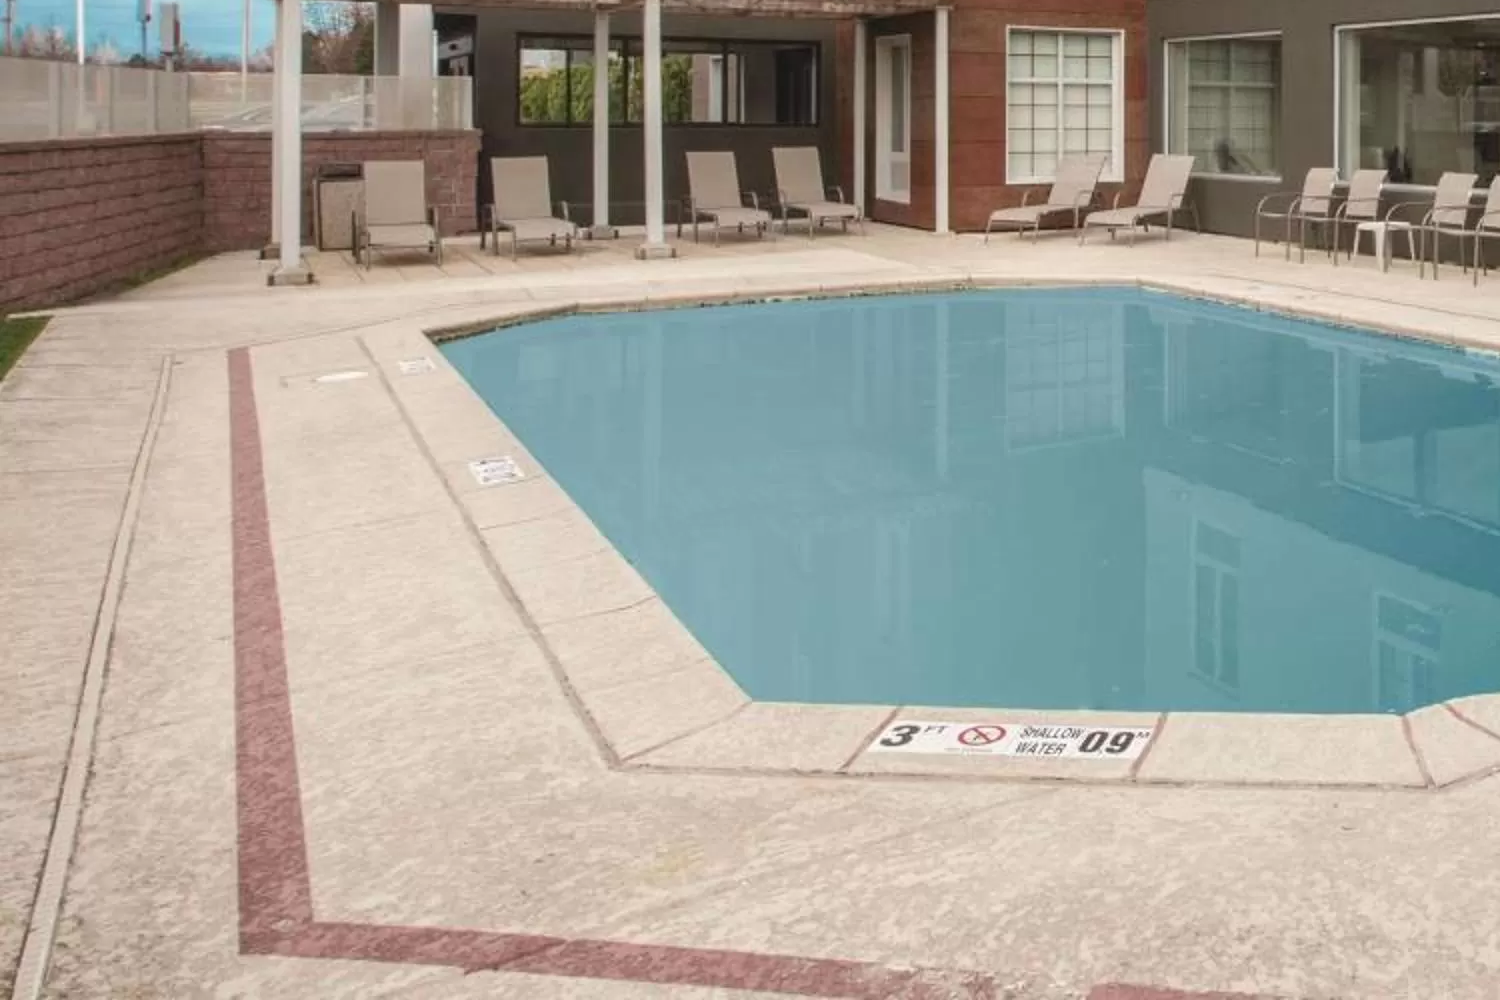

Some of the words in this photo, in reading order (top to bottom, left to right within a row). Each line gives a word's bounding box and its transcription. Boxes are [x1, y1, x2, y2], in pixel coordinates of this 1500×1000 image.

[880, 725, 921, 746] 3
[1020, 726, 1084, 739] SHALLOW
[1015, 741, 1067, 755] WATER
